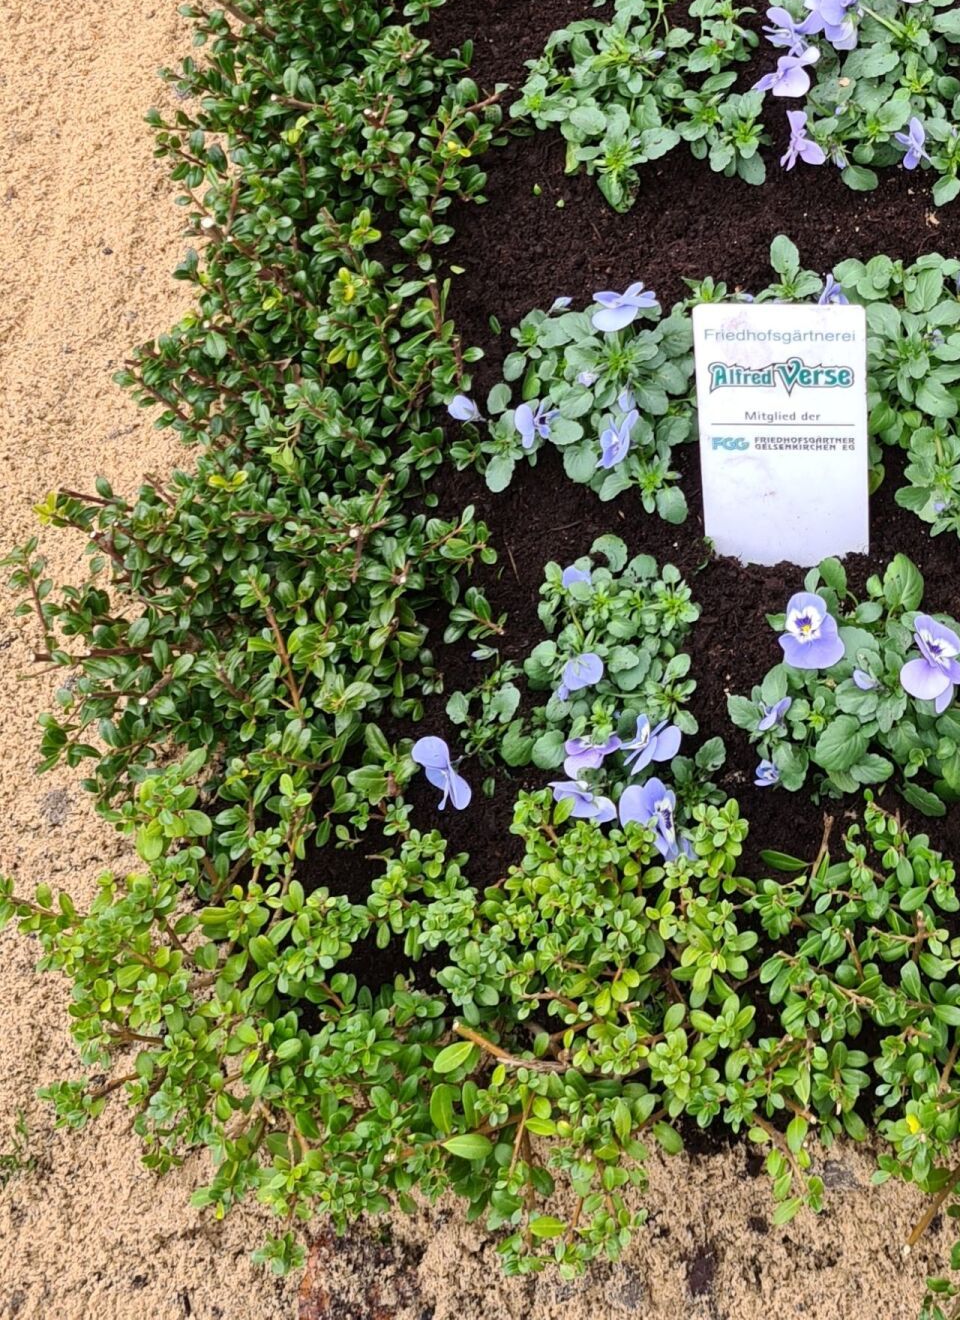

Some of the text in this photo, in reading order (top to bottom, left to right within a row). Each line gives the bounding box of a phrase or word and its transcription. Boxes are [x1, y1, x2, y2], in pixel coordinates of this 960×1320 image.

[704, 329, 856, 344] Friedhofsgärtnerei
[710, 359, 854, 390] Alfred Verse
[745, 411, 821, 423] Mitglied der
[711, 437, 750, 451] FGG
[755, 443, 855, 451] GELSENKIRCHEN EG
